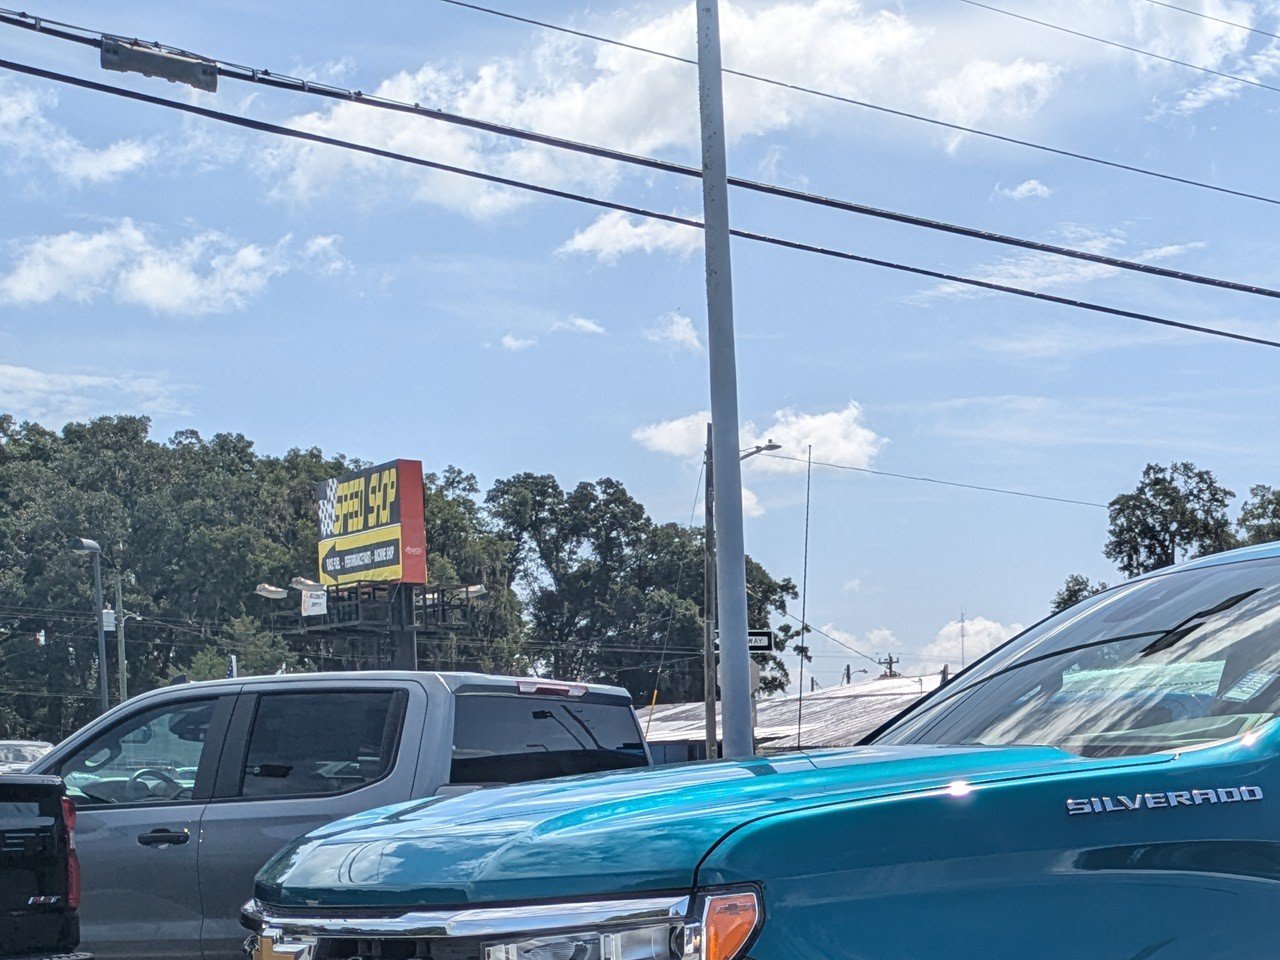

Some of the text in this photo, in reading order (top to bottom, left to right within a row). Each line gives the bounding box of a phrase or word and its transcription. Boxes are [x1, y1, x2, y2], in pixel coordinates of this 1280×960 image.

[333, 468, 397, 534] SPEED SHOP
[1066, 786, 1264, 815] SILVERADO
